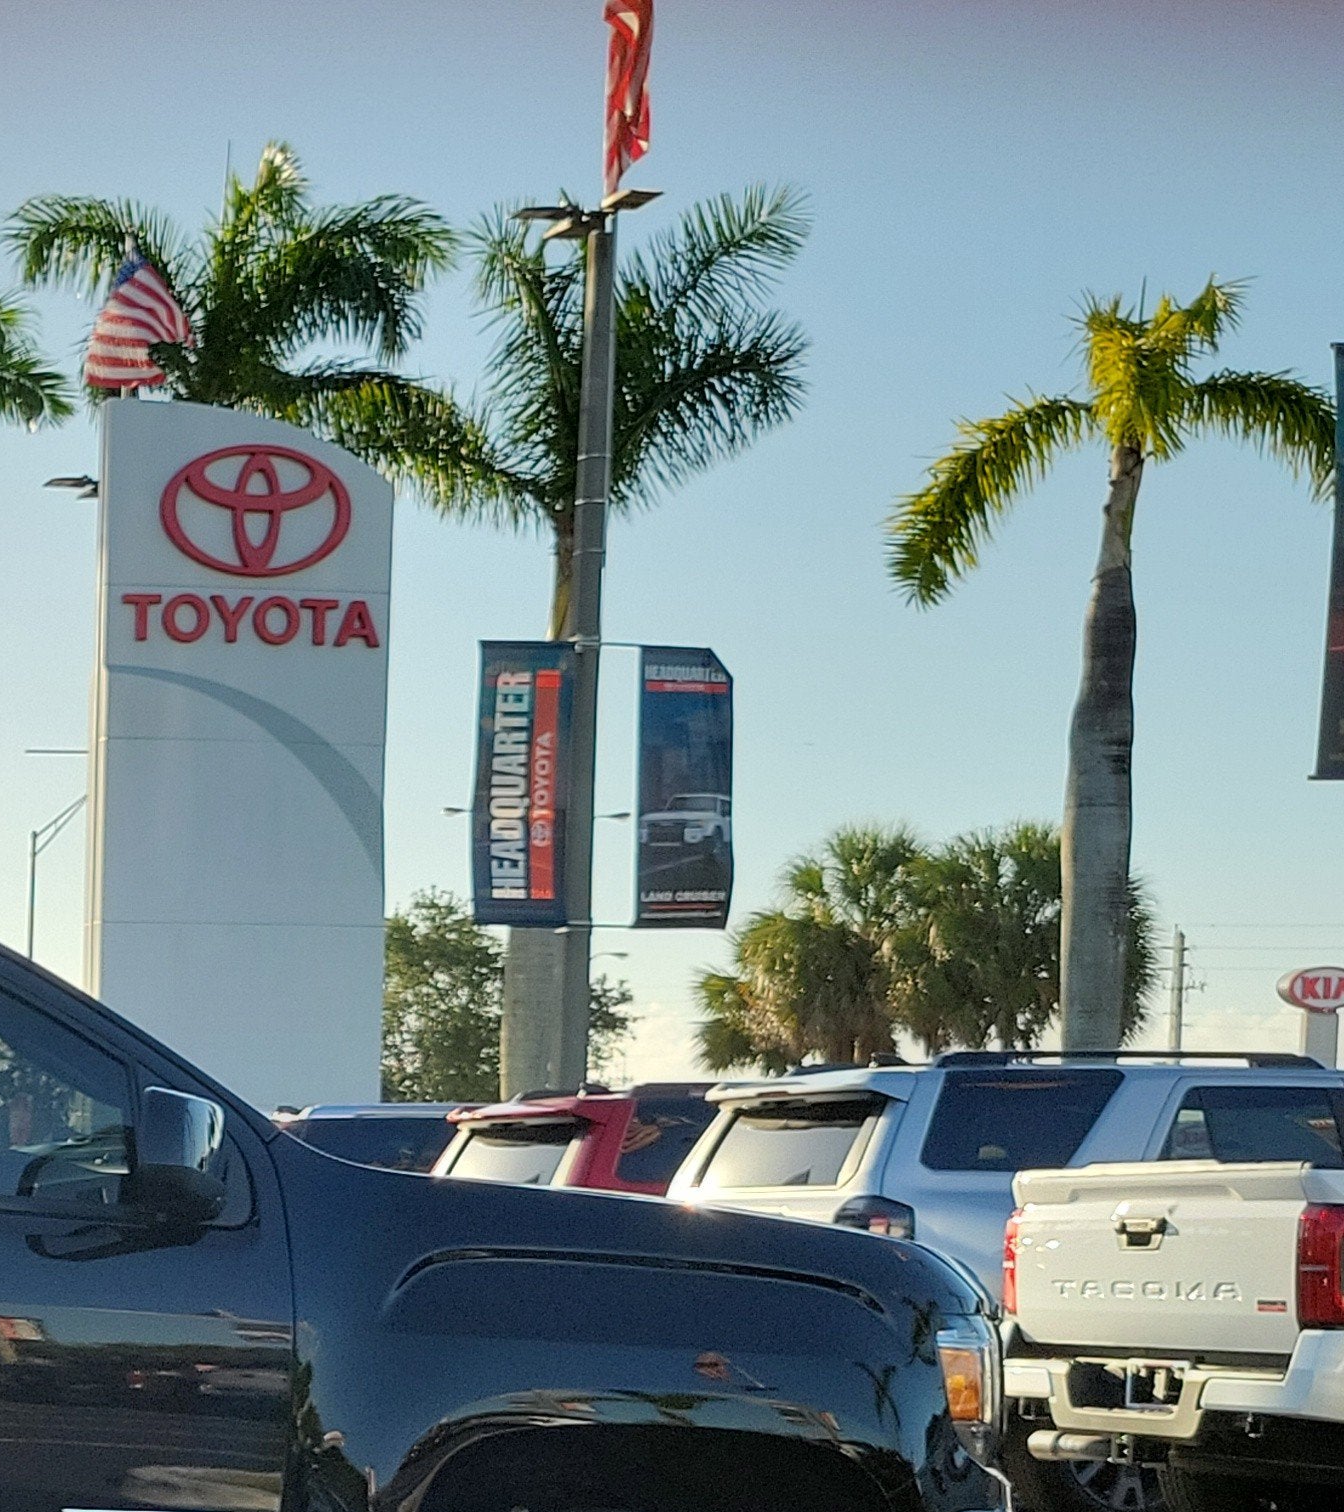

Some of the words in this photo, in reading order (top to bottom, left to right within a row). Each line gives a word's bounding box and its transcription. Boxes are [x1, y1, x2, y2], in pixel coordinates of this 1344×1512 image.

[122, 593, 379, 648] TOYOTA
[490, 672, 532, 899] HEADQUARTER
[533, 732, 552, 817] TOYOTA
[1052, 1280, 1242, 1301] TACOMA
